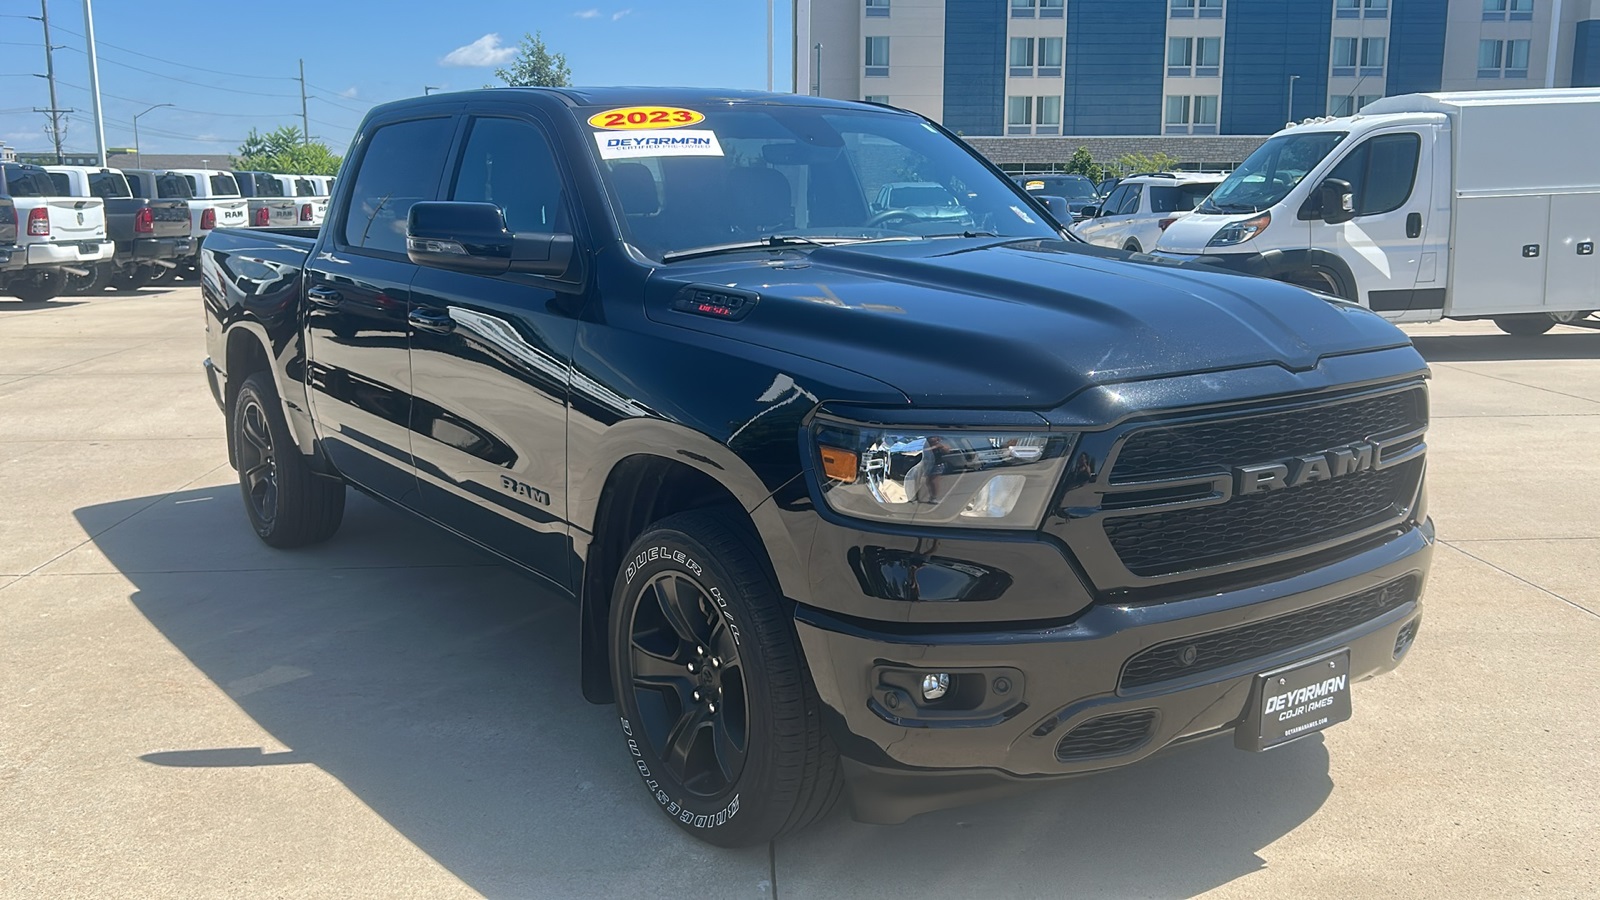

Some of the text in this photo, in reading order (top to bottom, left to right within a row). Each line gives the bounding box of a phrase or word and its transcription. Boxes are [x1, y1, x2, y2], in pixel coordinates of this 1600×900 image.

[604, 111, 693, 127] 2023
[607, 138, 711, 147] DEYARMAN
[224, 211, 244, 219] RAM
[1239, 440, 1373, 496] RAM
[500, 474, 551, 506] RAM
[625, 546, 703, 585] DUELER
[1264, 674, 1346, 715] DEYARMAN
[1279, 696, 1333, 721] CDJR AMES
[620, 716, 740, 829] BRIDGESTONE
